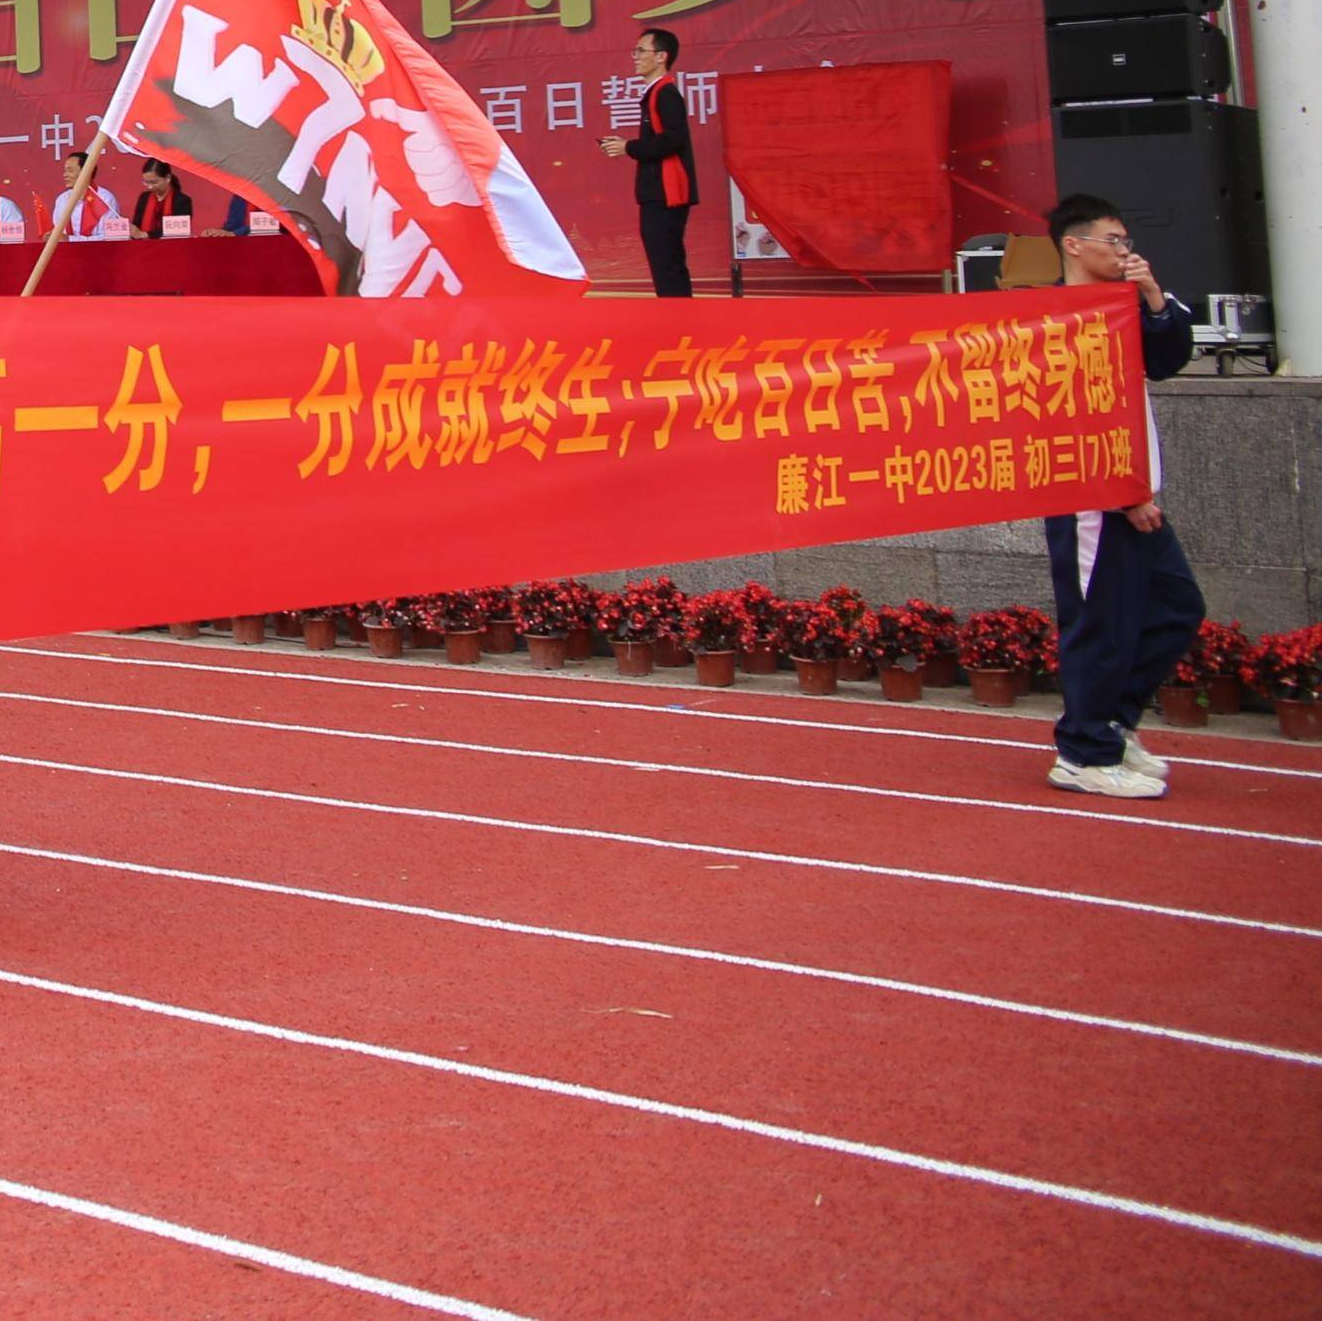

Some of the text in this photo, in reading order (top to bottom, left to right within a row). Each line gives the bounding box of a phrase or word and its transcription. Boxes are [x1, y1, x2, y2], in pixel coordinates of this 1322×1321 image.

[775, 426, 1134, 515] 廉江一中2023届 初三(7)班
